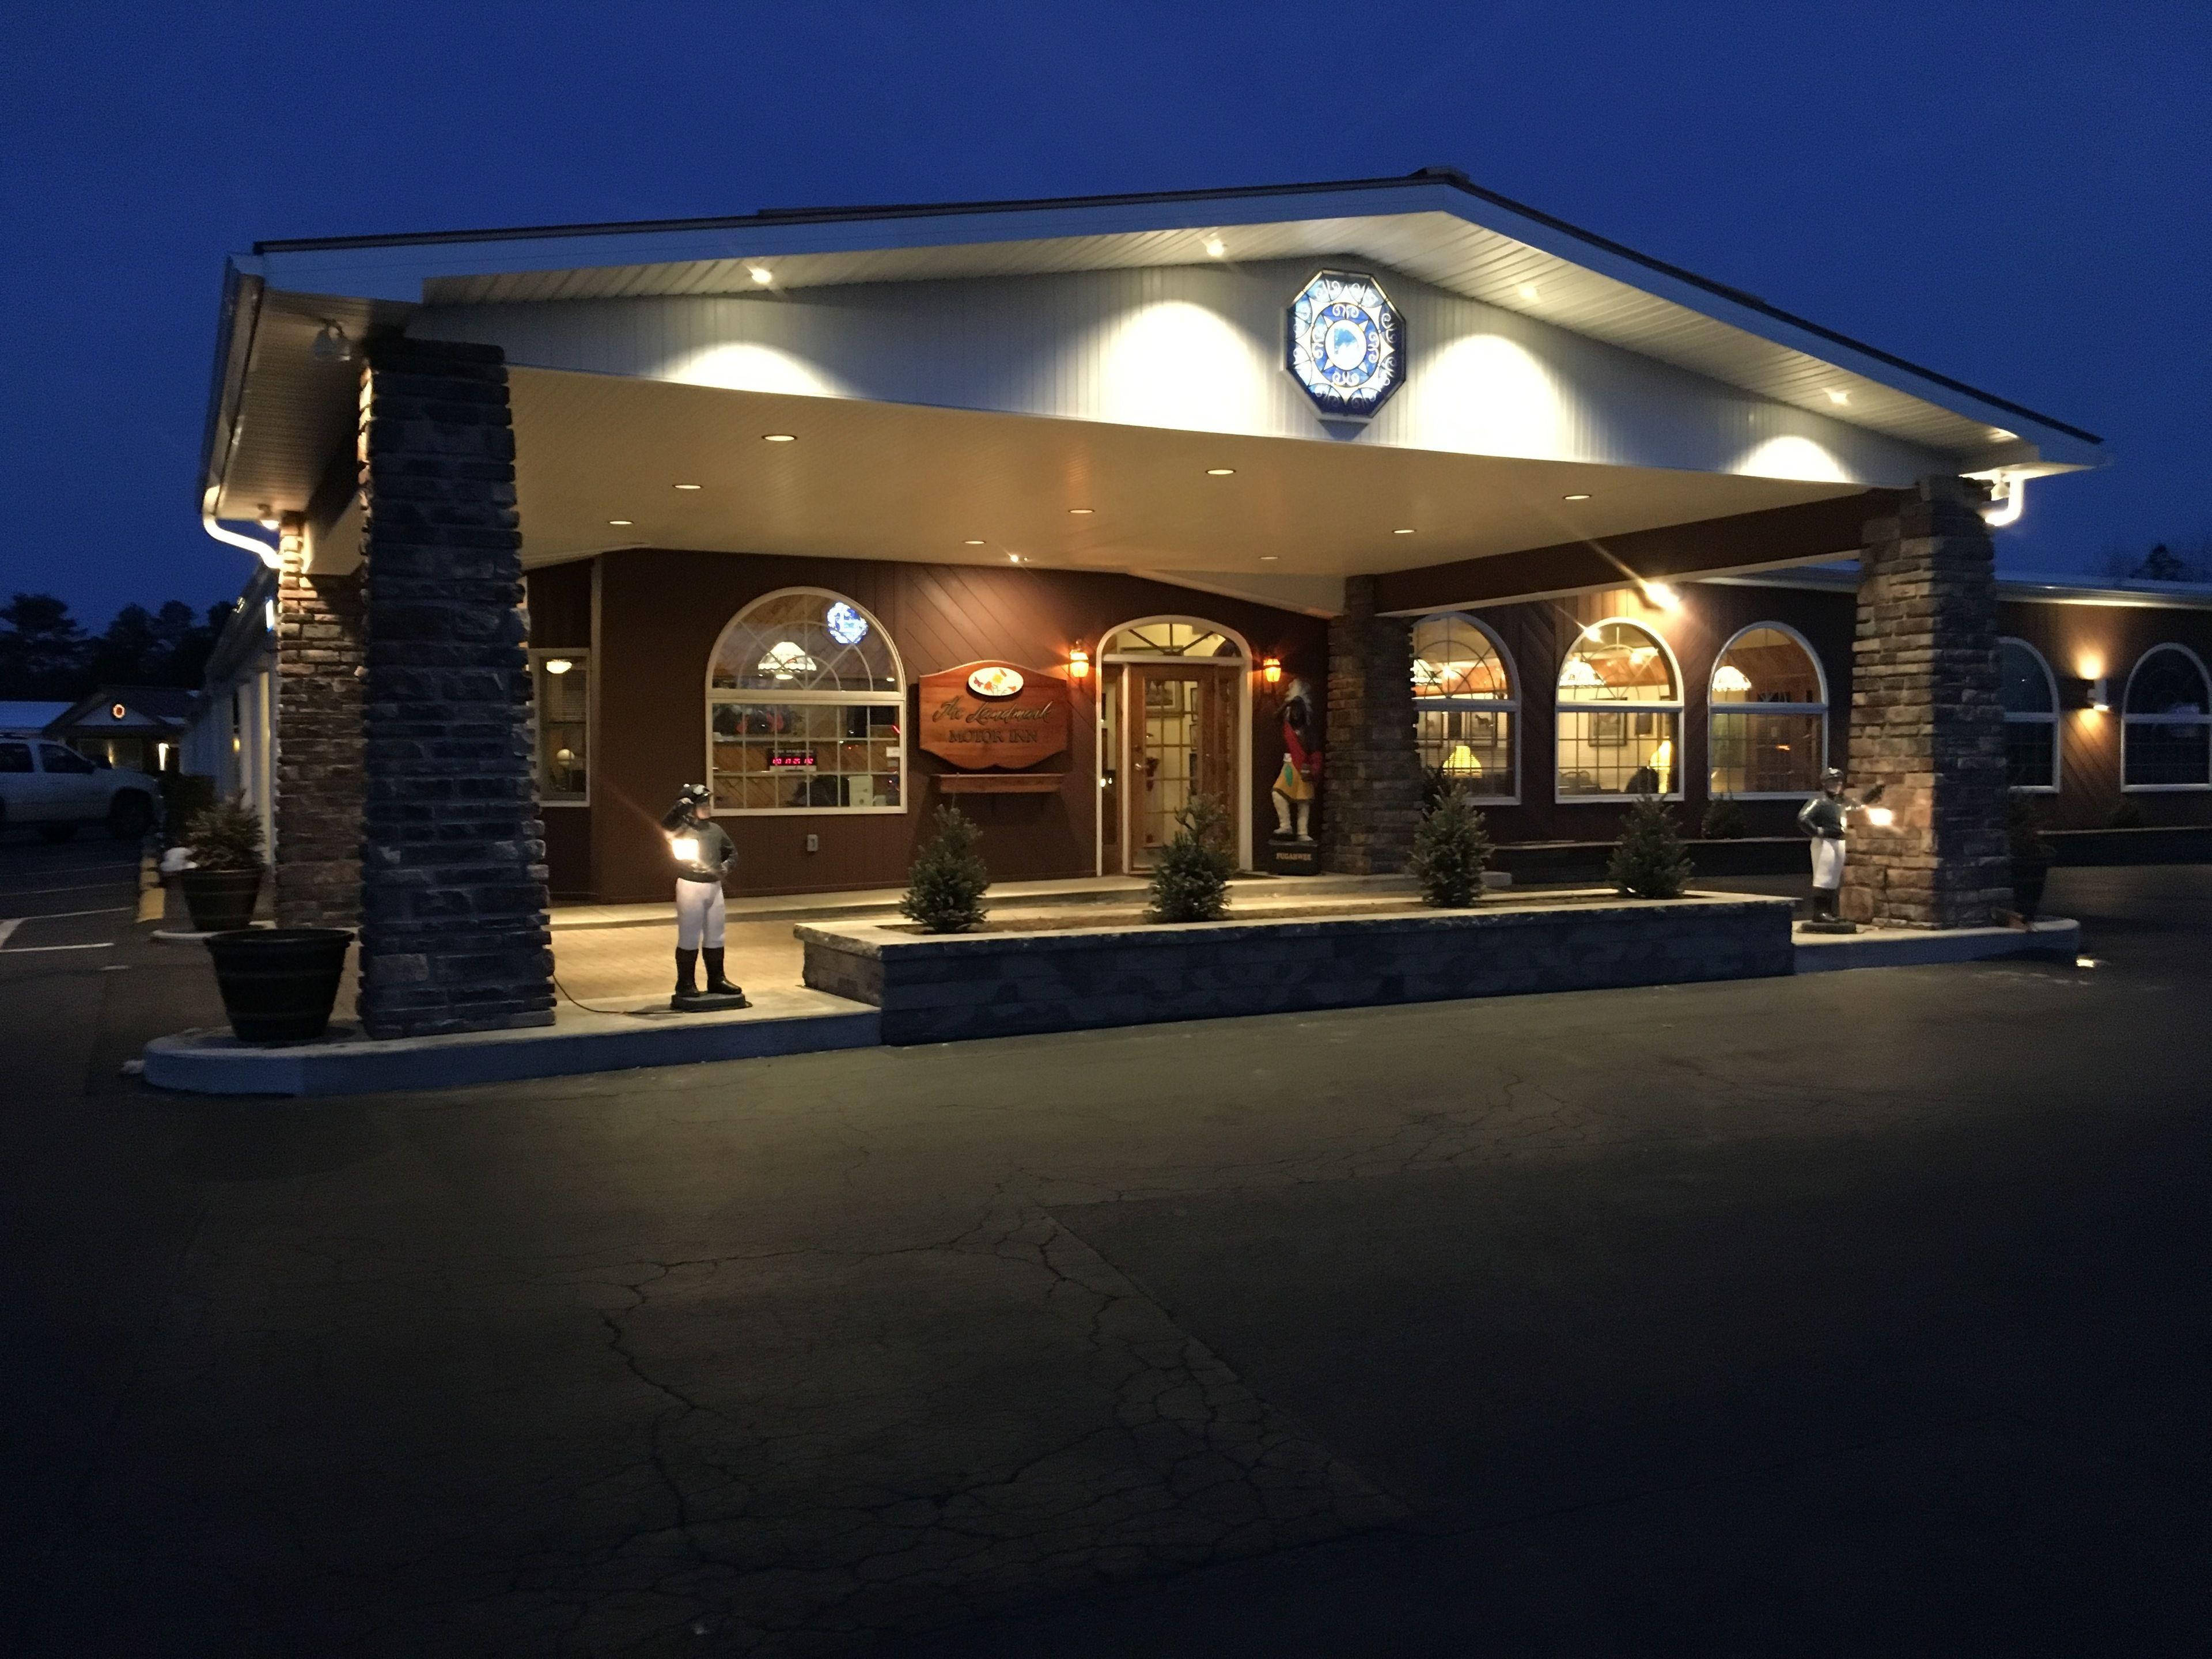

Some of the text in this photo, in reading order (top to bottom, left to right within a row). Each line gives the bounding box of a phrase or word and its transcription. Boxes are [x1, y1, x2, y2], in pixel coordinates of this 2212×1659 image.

[932, 695, 1054, 725] The Landmark
[949, 729, 1037, 743] MOTOR INN
